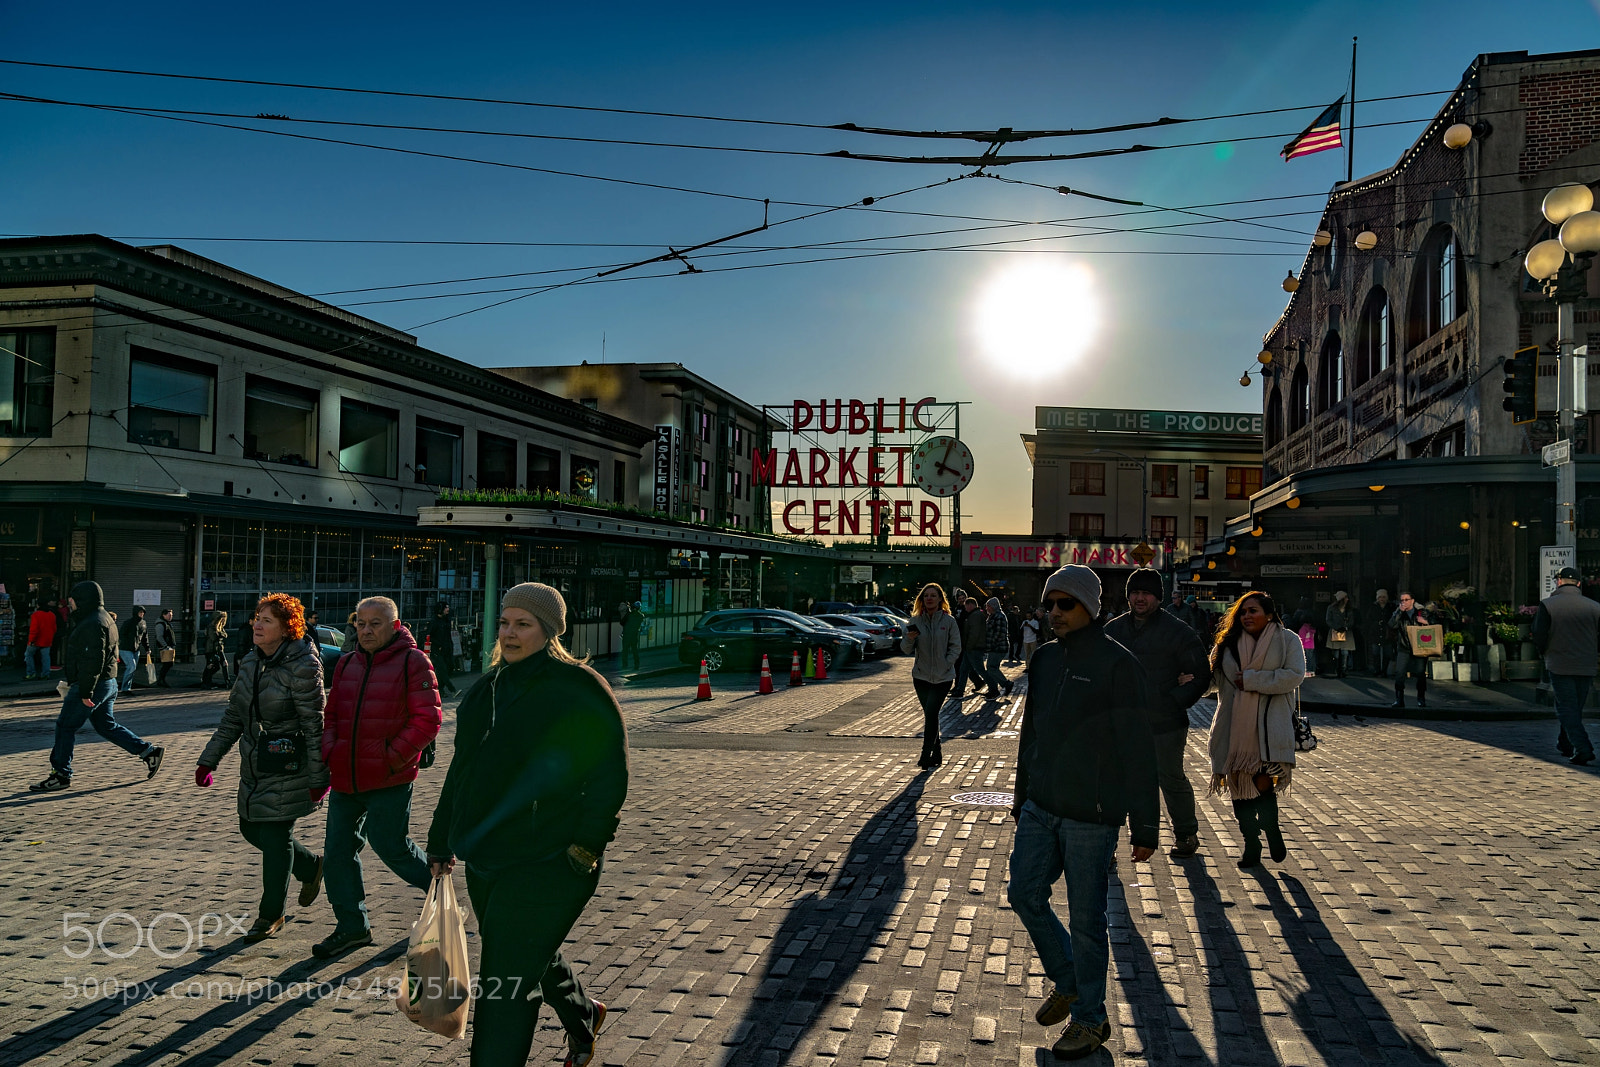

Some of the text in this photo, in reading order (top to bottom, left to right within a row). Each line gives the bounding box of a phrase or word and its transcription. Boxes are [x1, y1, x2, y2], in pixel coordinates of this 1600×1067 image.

[793, 397, 936, 435] PUBLIC
[1047, 411, 1262, 432] MEET THE PRODUCE
[656, 428, 669, 514] LA SALLE HOT
[752, 447, 913, 488] MARKET
[0, 520, 15, 536] ce
[783, 500, 941, 536] CENTER
[1578, 528, 1600, 539] KE
[969, 545, 1060, 564] FARMERS
[1073, 548, 1157, 565] MARK
